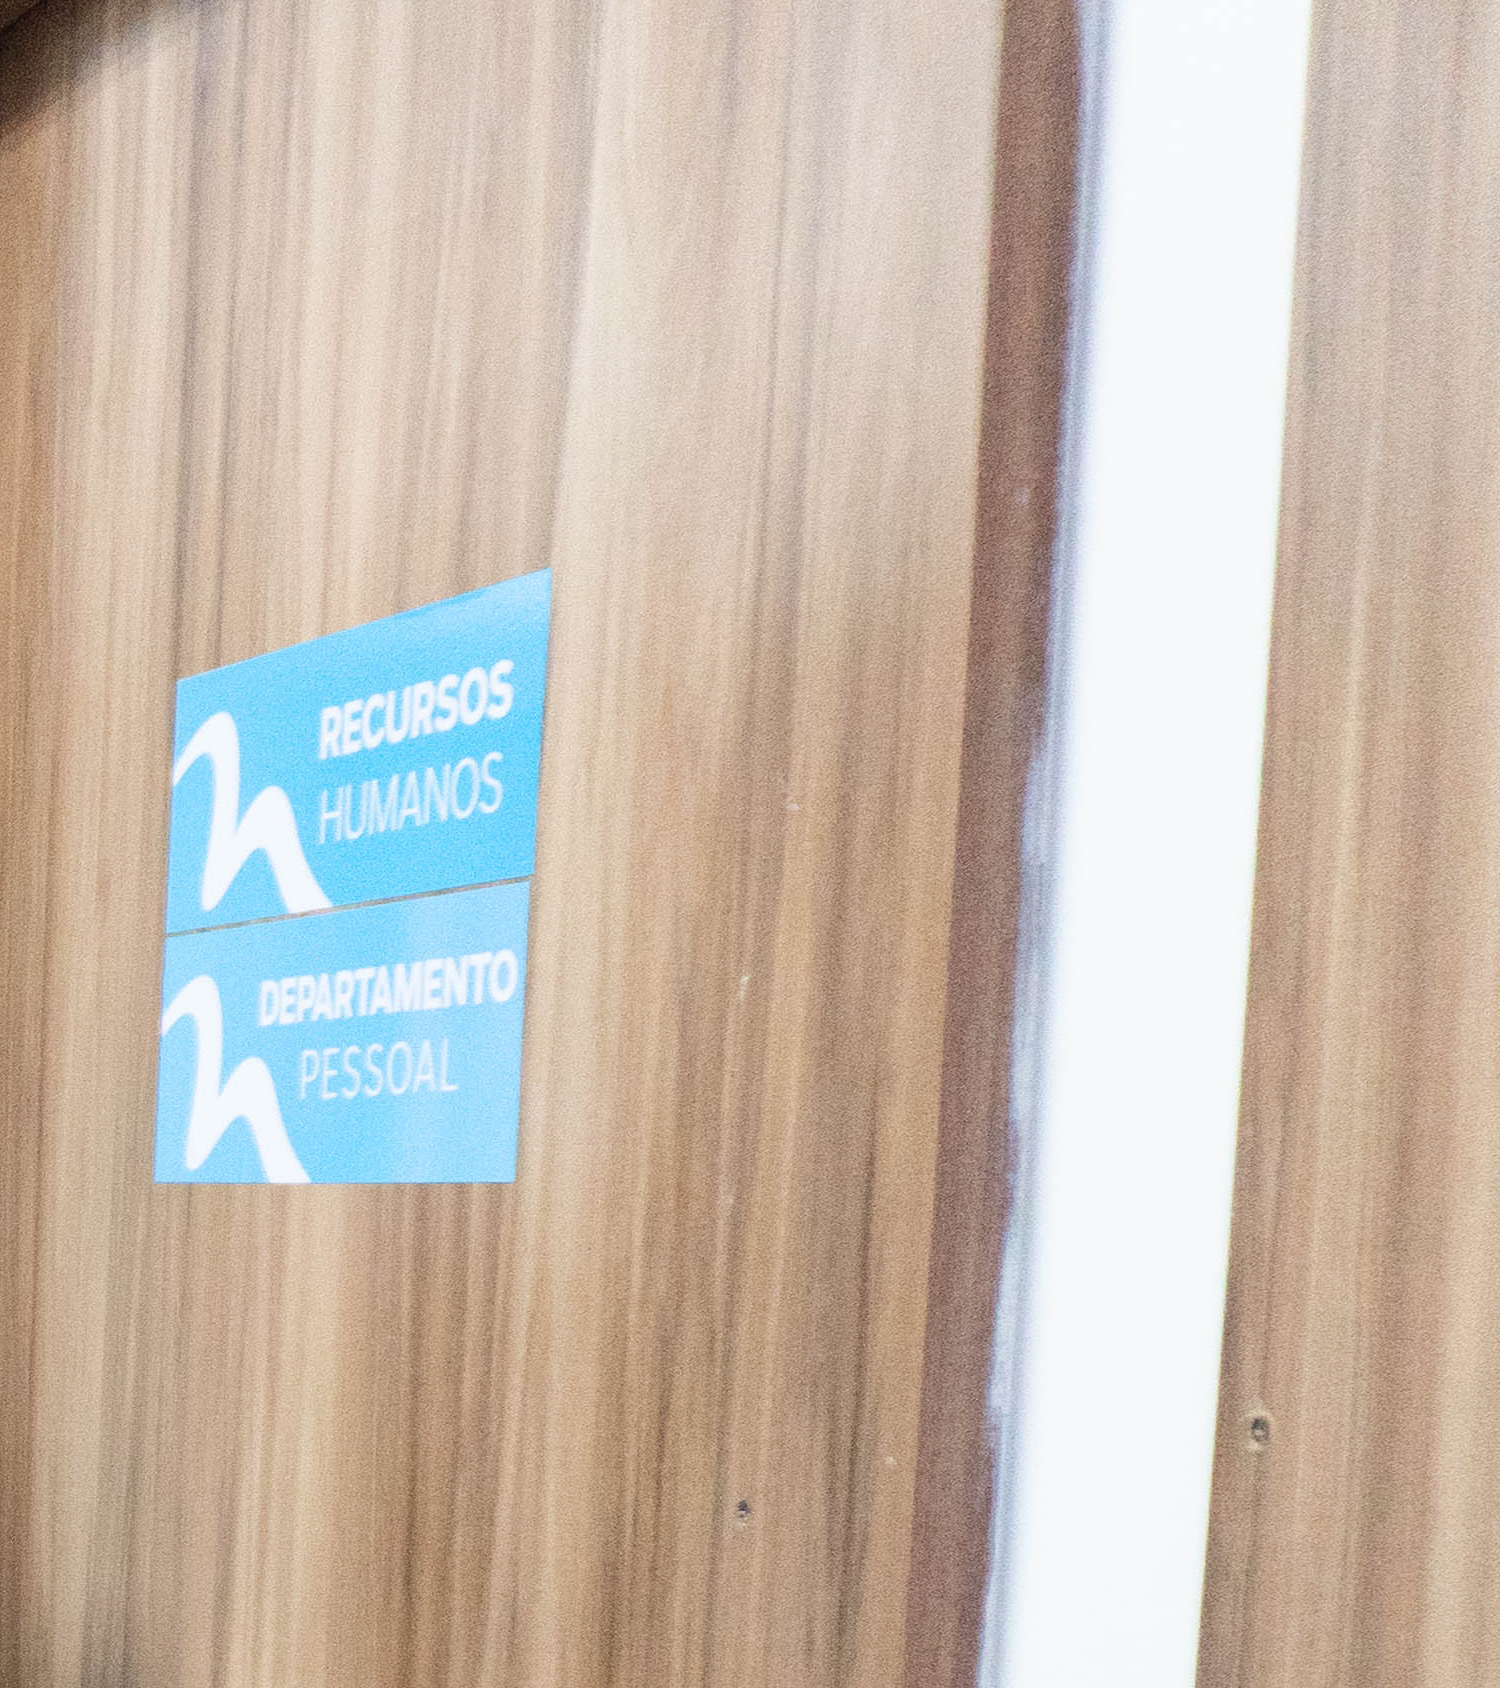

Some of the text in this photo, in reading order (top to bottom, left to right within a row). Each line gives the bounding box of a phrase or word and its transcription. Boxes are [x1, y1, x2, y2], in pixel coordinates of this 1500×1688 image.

[319, 660, 513, 760] RECURSOS
[319, 751, 504, 844] HUMANOS
[257, 950, 518, 1027] DEPARTAMENTO
[300, 1039, 457, 1100] PESSOAL
